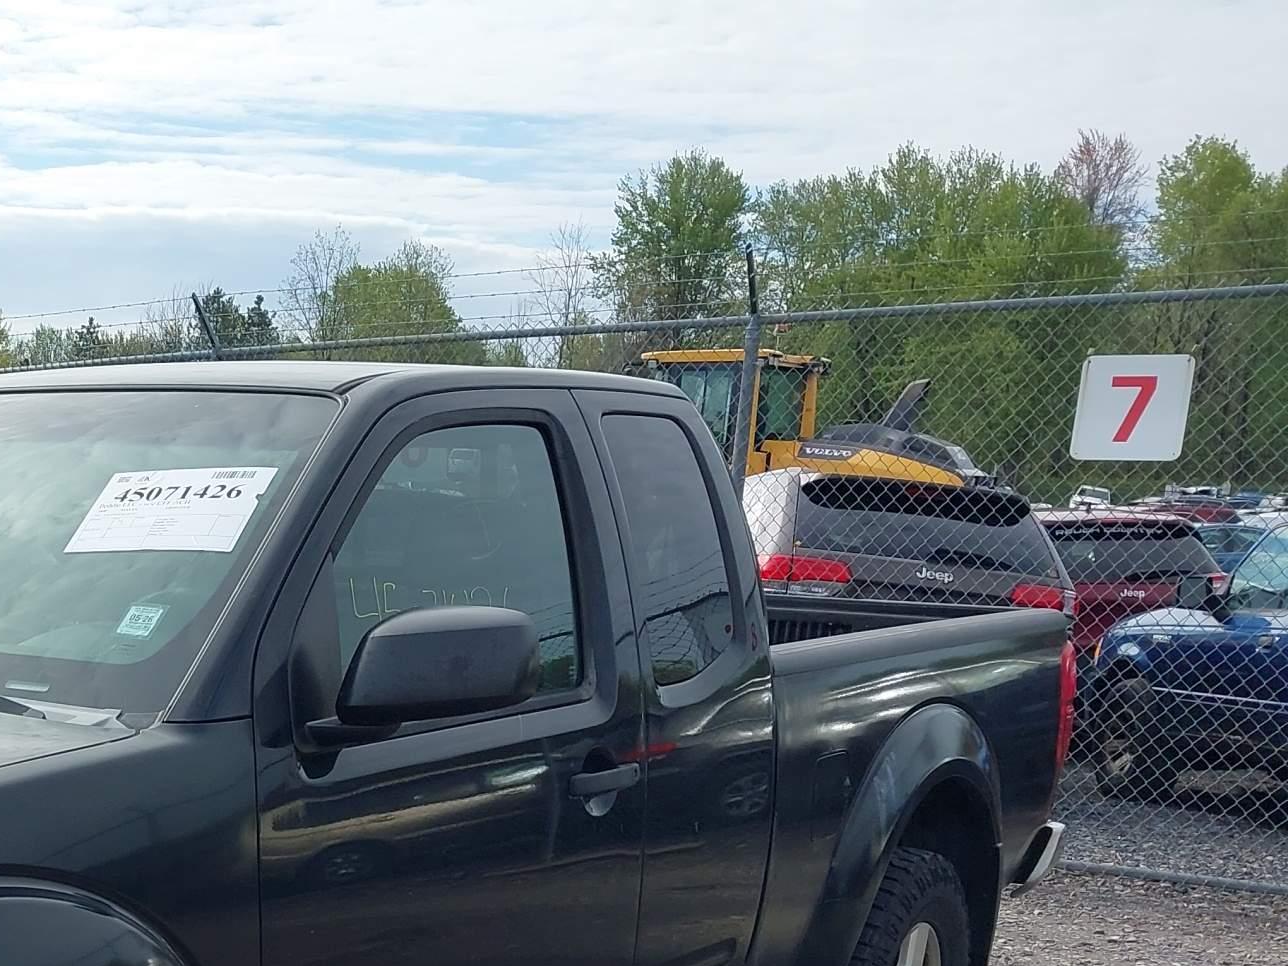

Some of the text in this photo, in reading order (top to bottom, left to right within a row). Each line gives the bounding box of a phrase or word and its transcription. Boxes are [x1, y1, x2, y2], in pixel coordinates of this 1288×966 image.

[1112, 376, 1158, 442] 7
[805, 447, 852, 457] VOLVO
[114, 484, 247, 502] 45071426
[915, 567, 954, 584] Jeep
[1120, 589, 1145, 600] Jeep
